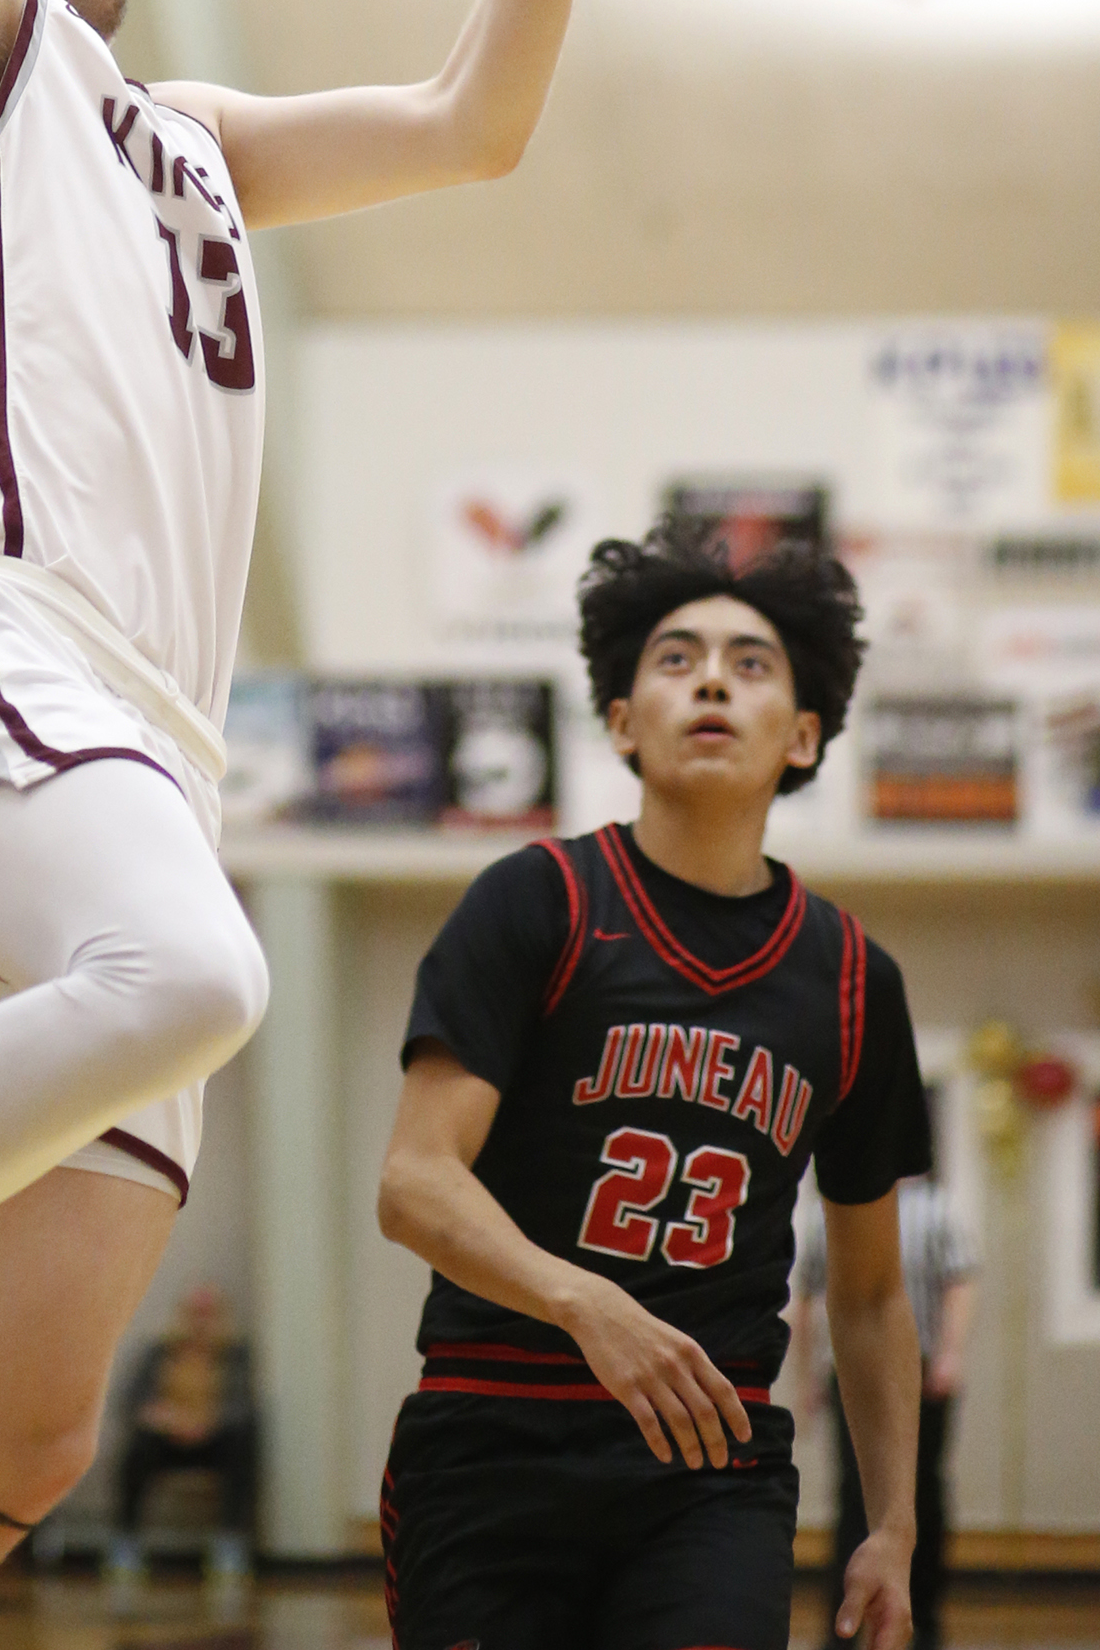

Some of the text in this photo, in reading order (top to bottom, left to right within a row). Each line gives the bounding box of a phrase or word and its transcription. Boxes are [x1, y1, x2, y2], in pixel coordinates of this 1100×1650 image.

[152, 207, 256, 396] 13
[573, 1023, 812, 1156] JUNEAU
[577, 1126, 751, 1269] 23
